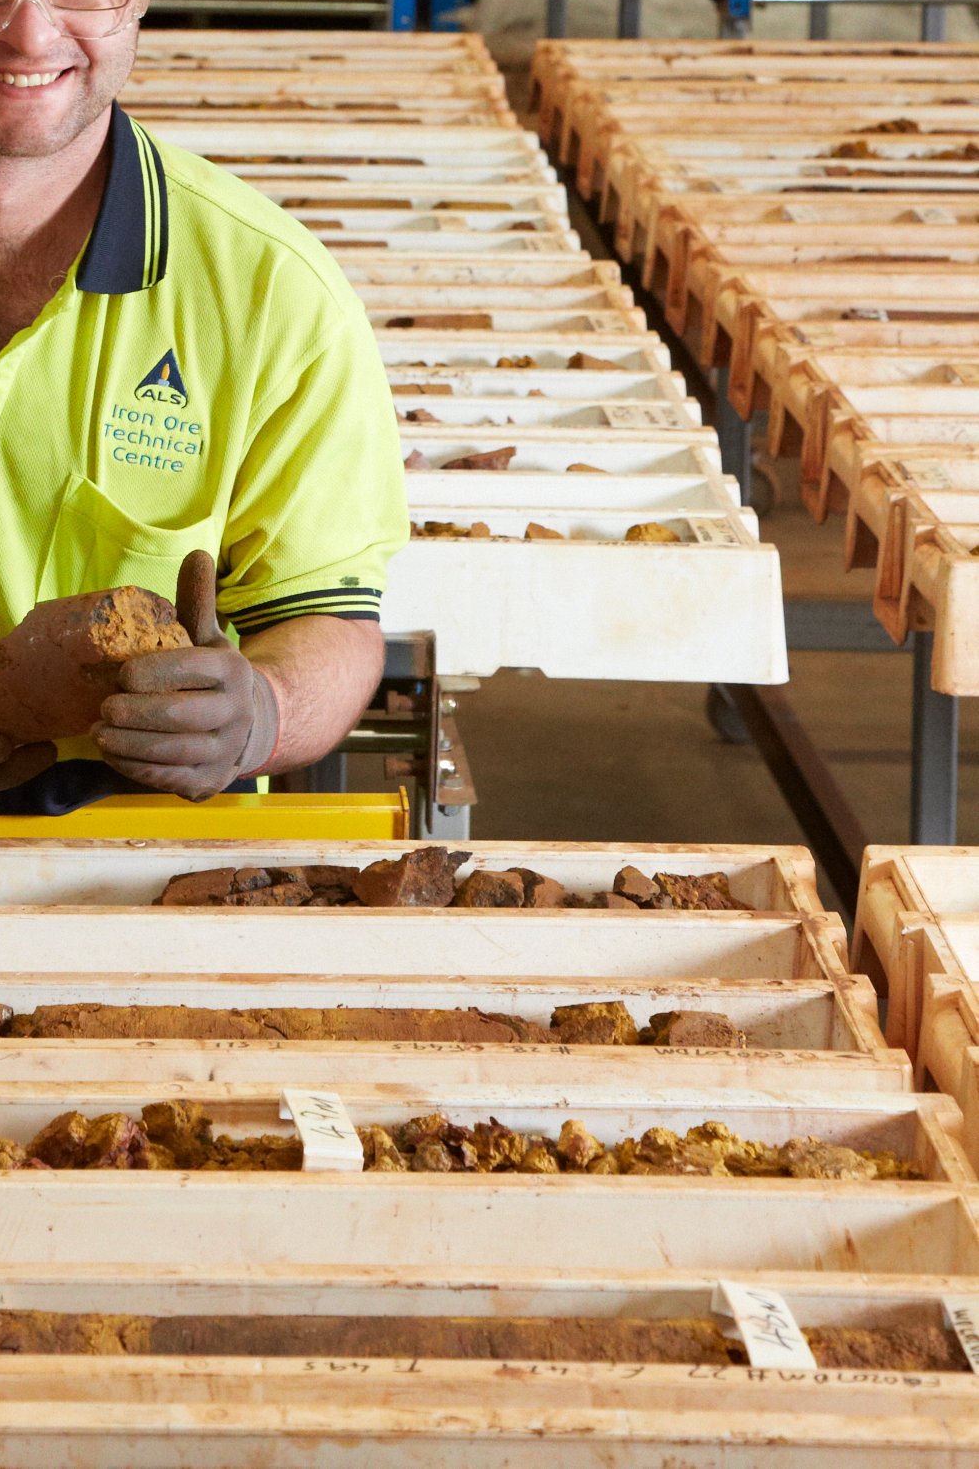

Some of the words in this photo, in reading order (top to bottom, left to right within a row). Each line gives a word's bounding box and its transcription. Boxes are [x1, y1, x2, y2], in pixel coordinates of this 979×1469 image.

[140, 388, 182, 405] ALS
[110, 404, 154, 426] Iron
[163, 415, 202, 435] Ore
[102, 423, 204, 456] Technical
[112, 446, 184, 473] Centre
